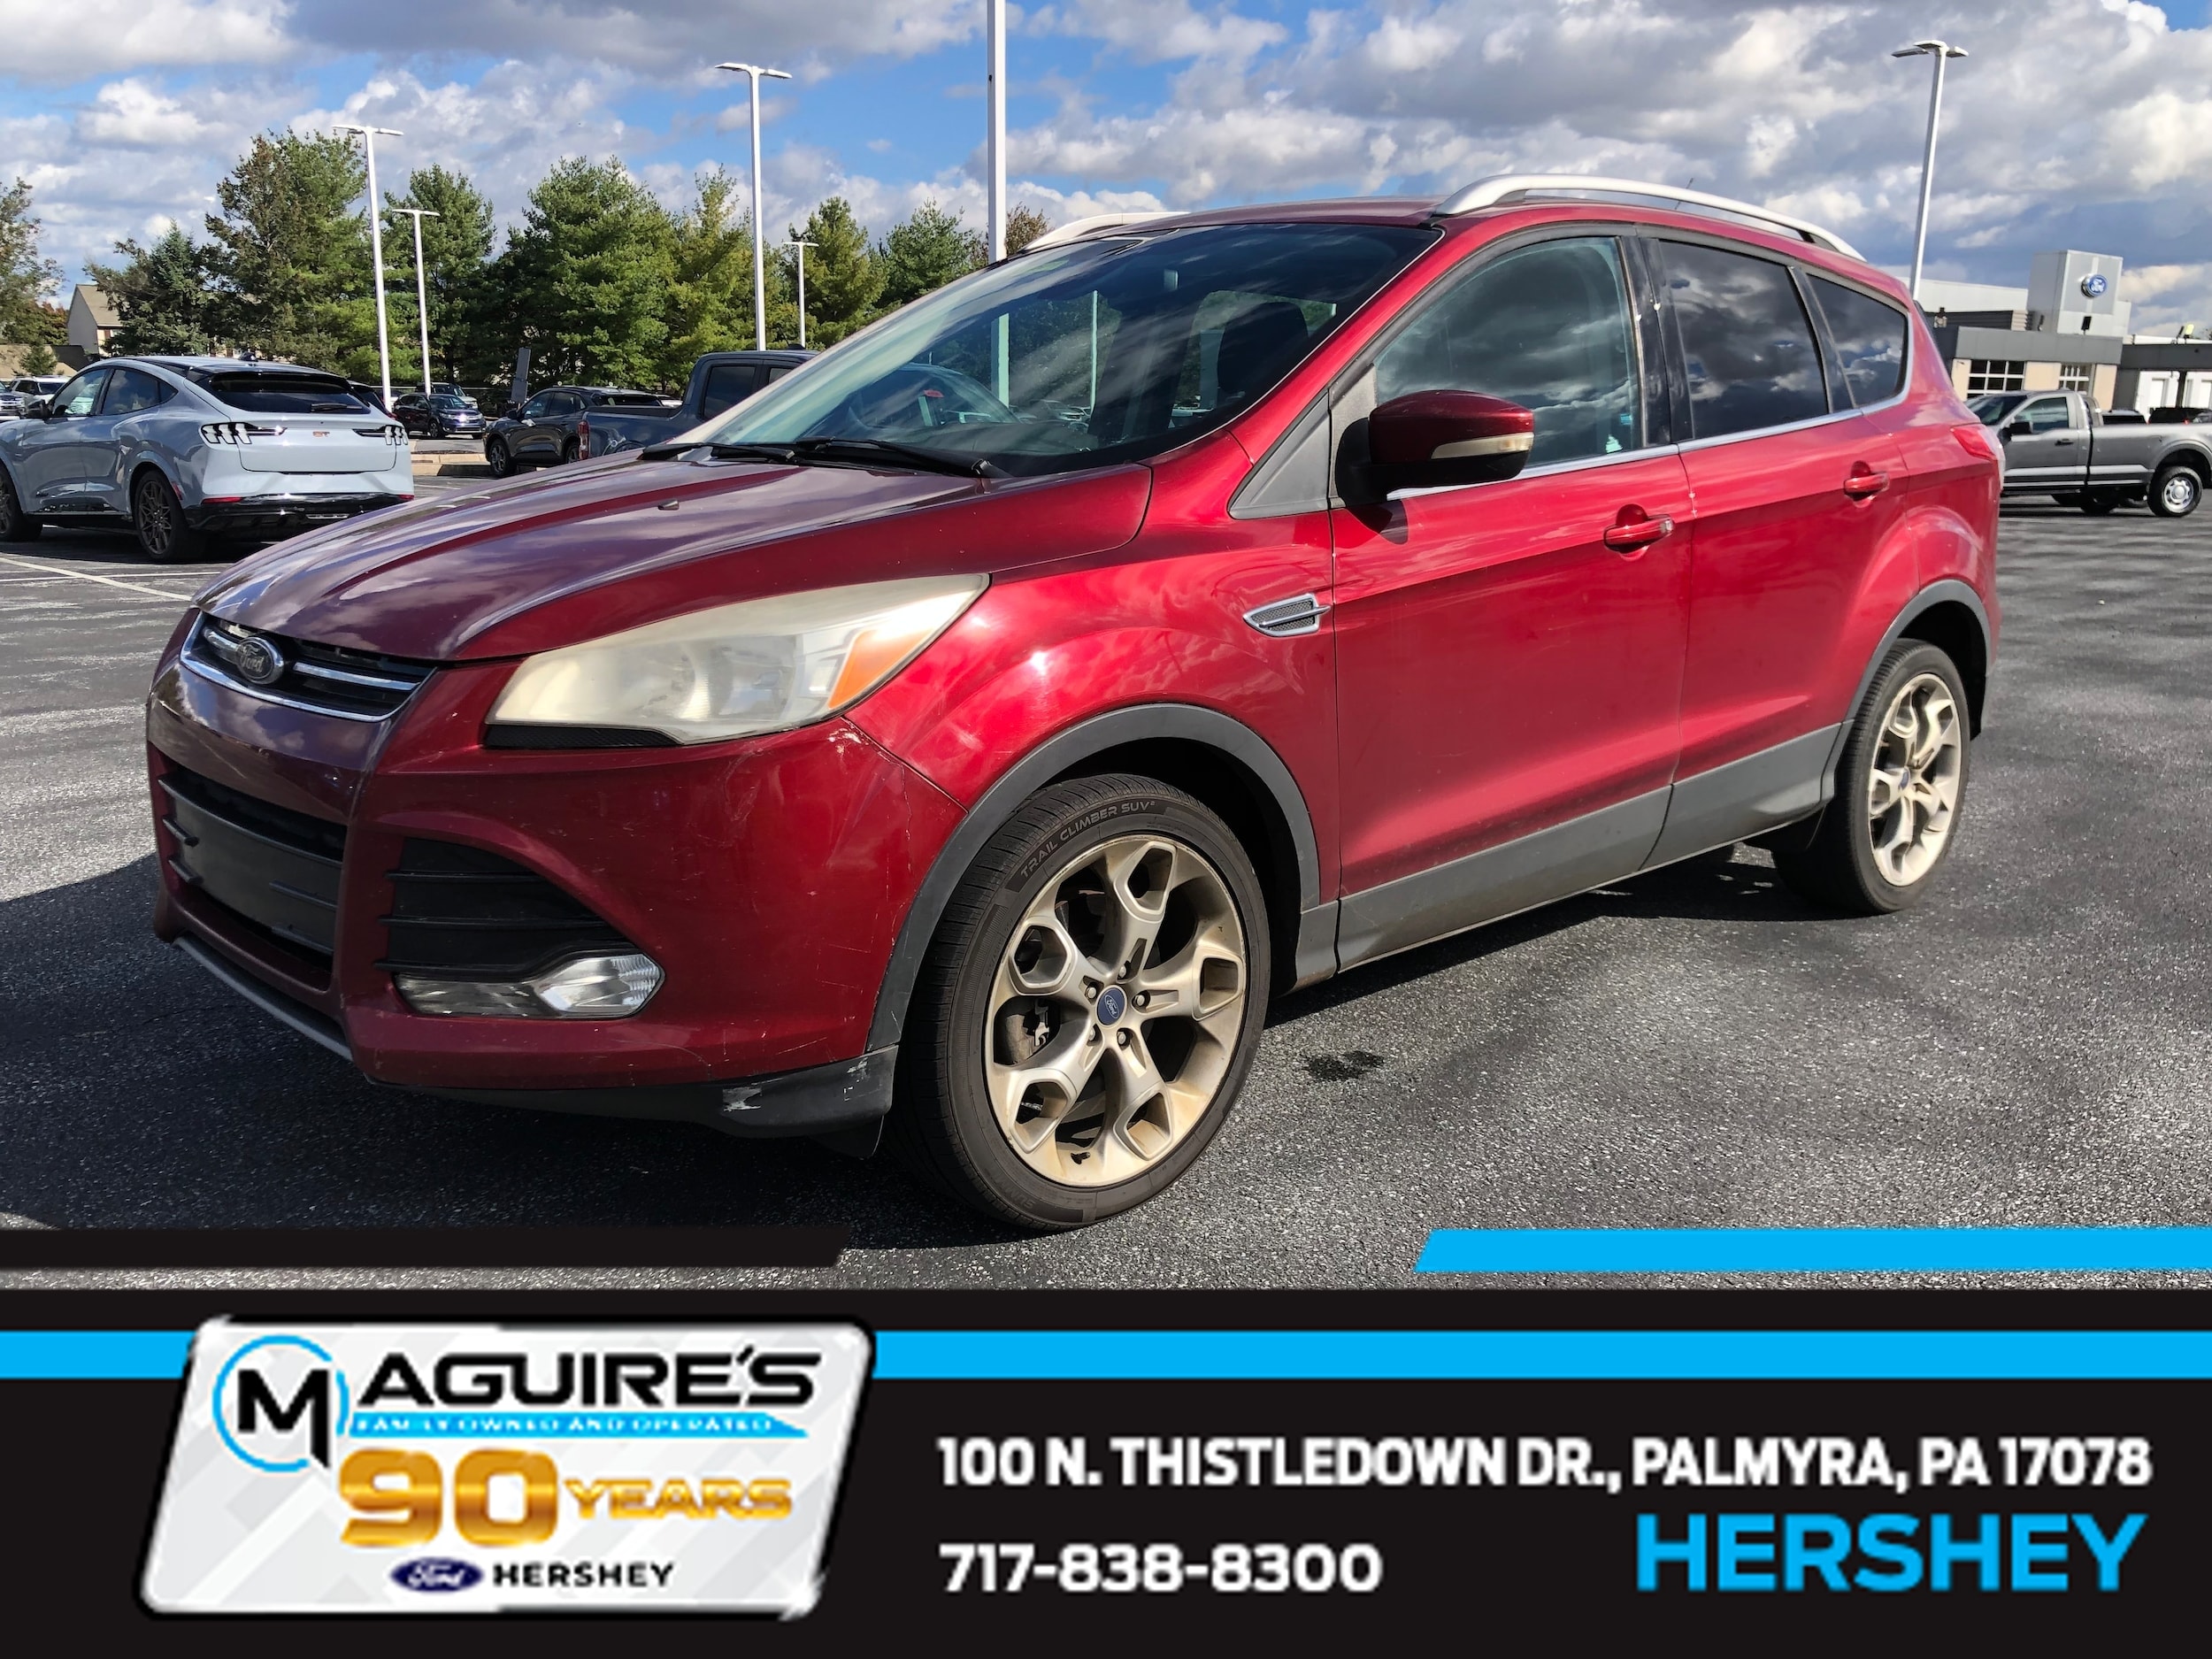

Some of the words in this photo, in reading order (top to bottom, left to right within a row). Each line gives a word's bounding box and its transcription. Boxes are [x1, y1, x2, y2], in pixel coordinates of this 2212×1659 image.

[235, 643, 265, 673] Ford
[1020, 841, 1058, 879] TRAIL
[1060, 805, 1118, 841] CLIMBER
[1106, 998, 1118, 1016] Ford
